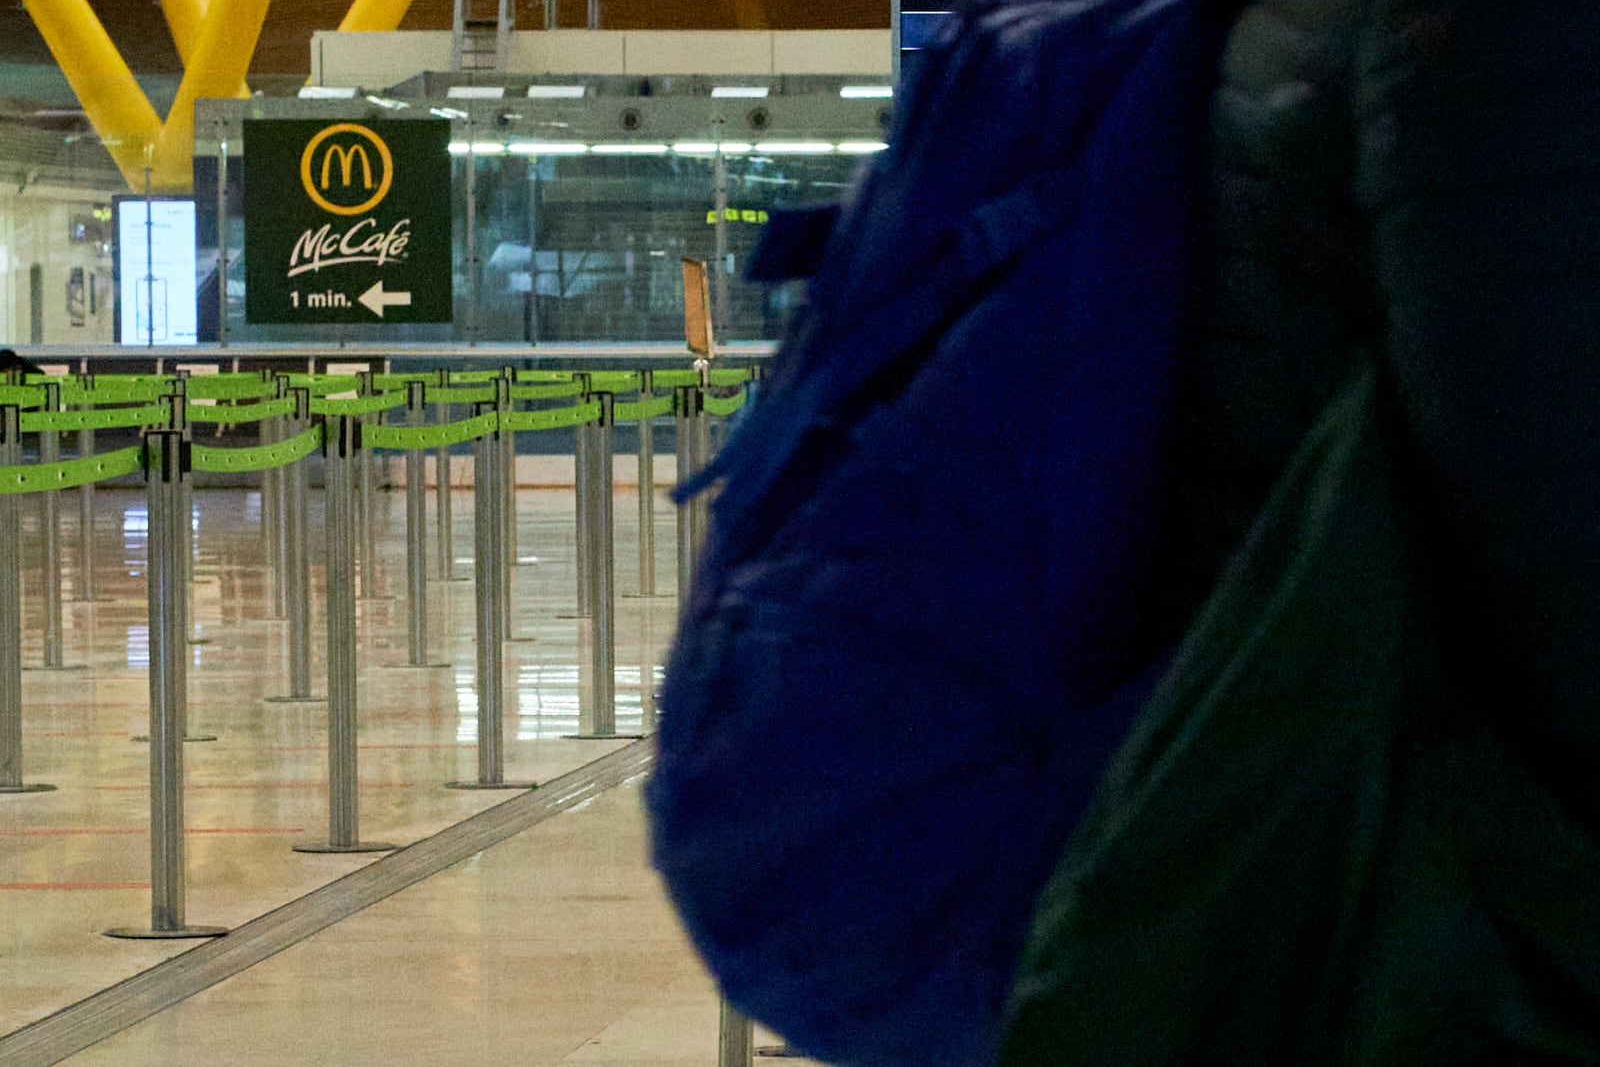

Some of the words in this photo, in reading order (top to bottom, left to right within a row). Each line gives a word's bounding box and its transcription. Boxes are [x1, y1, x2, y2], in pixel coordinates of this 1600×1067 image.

[288, 218, 411, 272] McCafé
[290, 291, 299, 307] 1
[308, 290, 352, 308] min.
